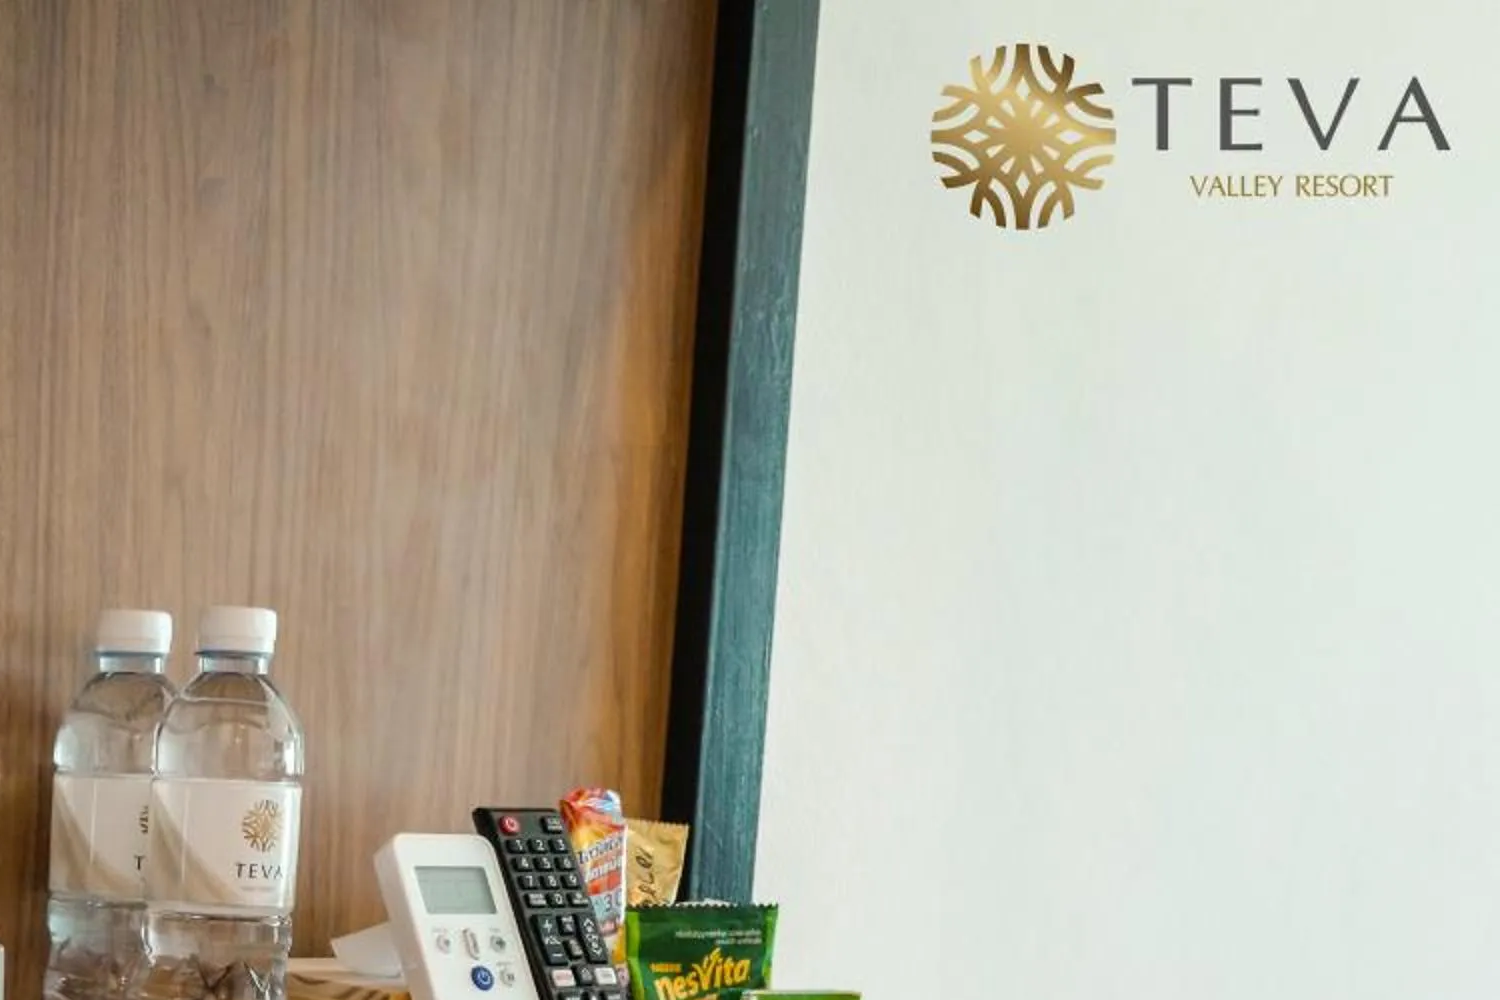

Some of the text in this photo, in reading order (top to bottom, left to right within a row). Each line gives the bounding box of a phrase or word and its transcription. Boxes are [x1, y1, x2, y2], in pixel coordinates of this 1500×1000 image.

[535, 839, 545, 851] 2
[557, 839, 566, 851] 3
[520, 857, 572, 869] 4 5 6
[235, 862, 284, 880] TEVA
[525, 875, 534, 887] 7
[547, 875, 557, 887] 8
[554, 893, 563, 905] 0
